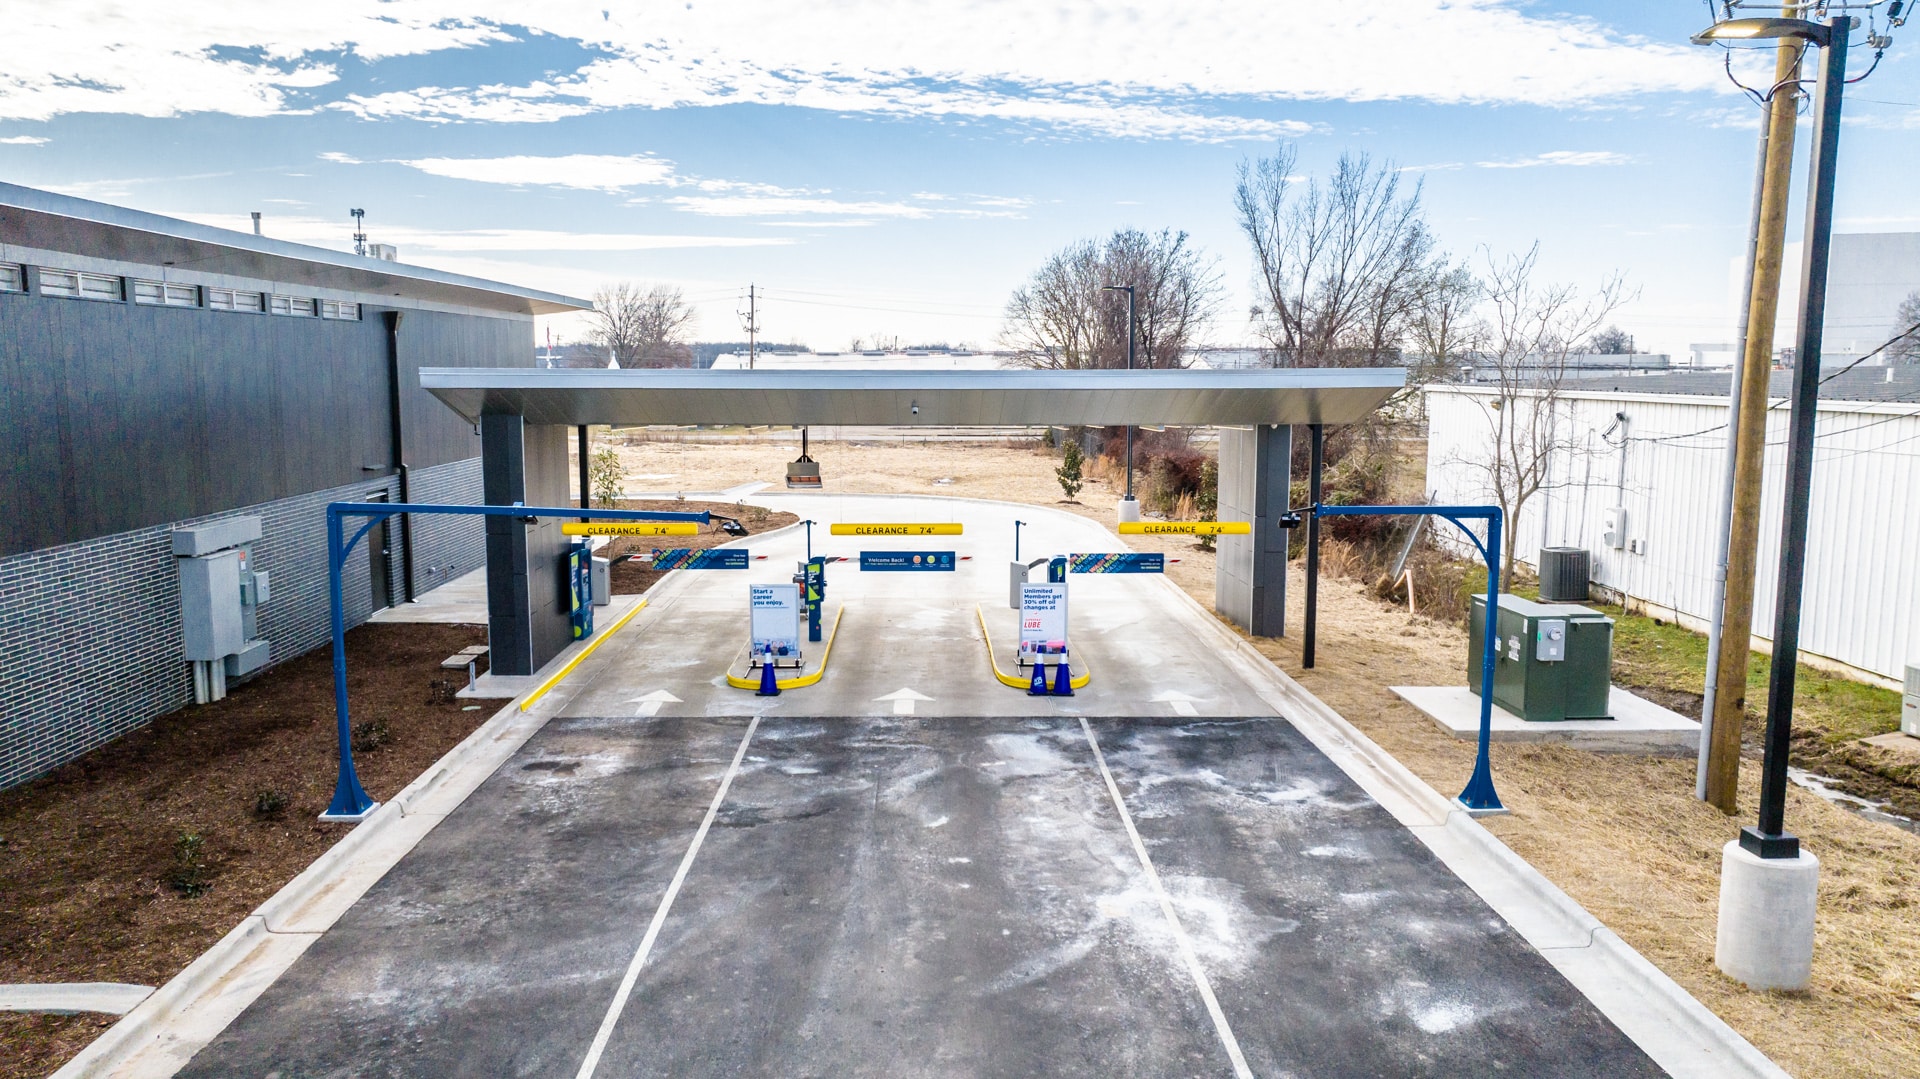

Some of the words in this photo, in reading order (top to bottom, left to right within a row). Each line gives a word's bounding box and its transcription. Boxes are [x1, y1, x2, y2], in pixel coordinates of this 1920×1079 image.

[587, 527, 640, 535] CLEARANCE
[654, 527, 670, 535] 7'4"
[855, 527, 908, 535] CLEARANCE
[919, 527, 935, 535] 7'4"
[1144, 525, 1196, 533] CLEARANCE
